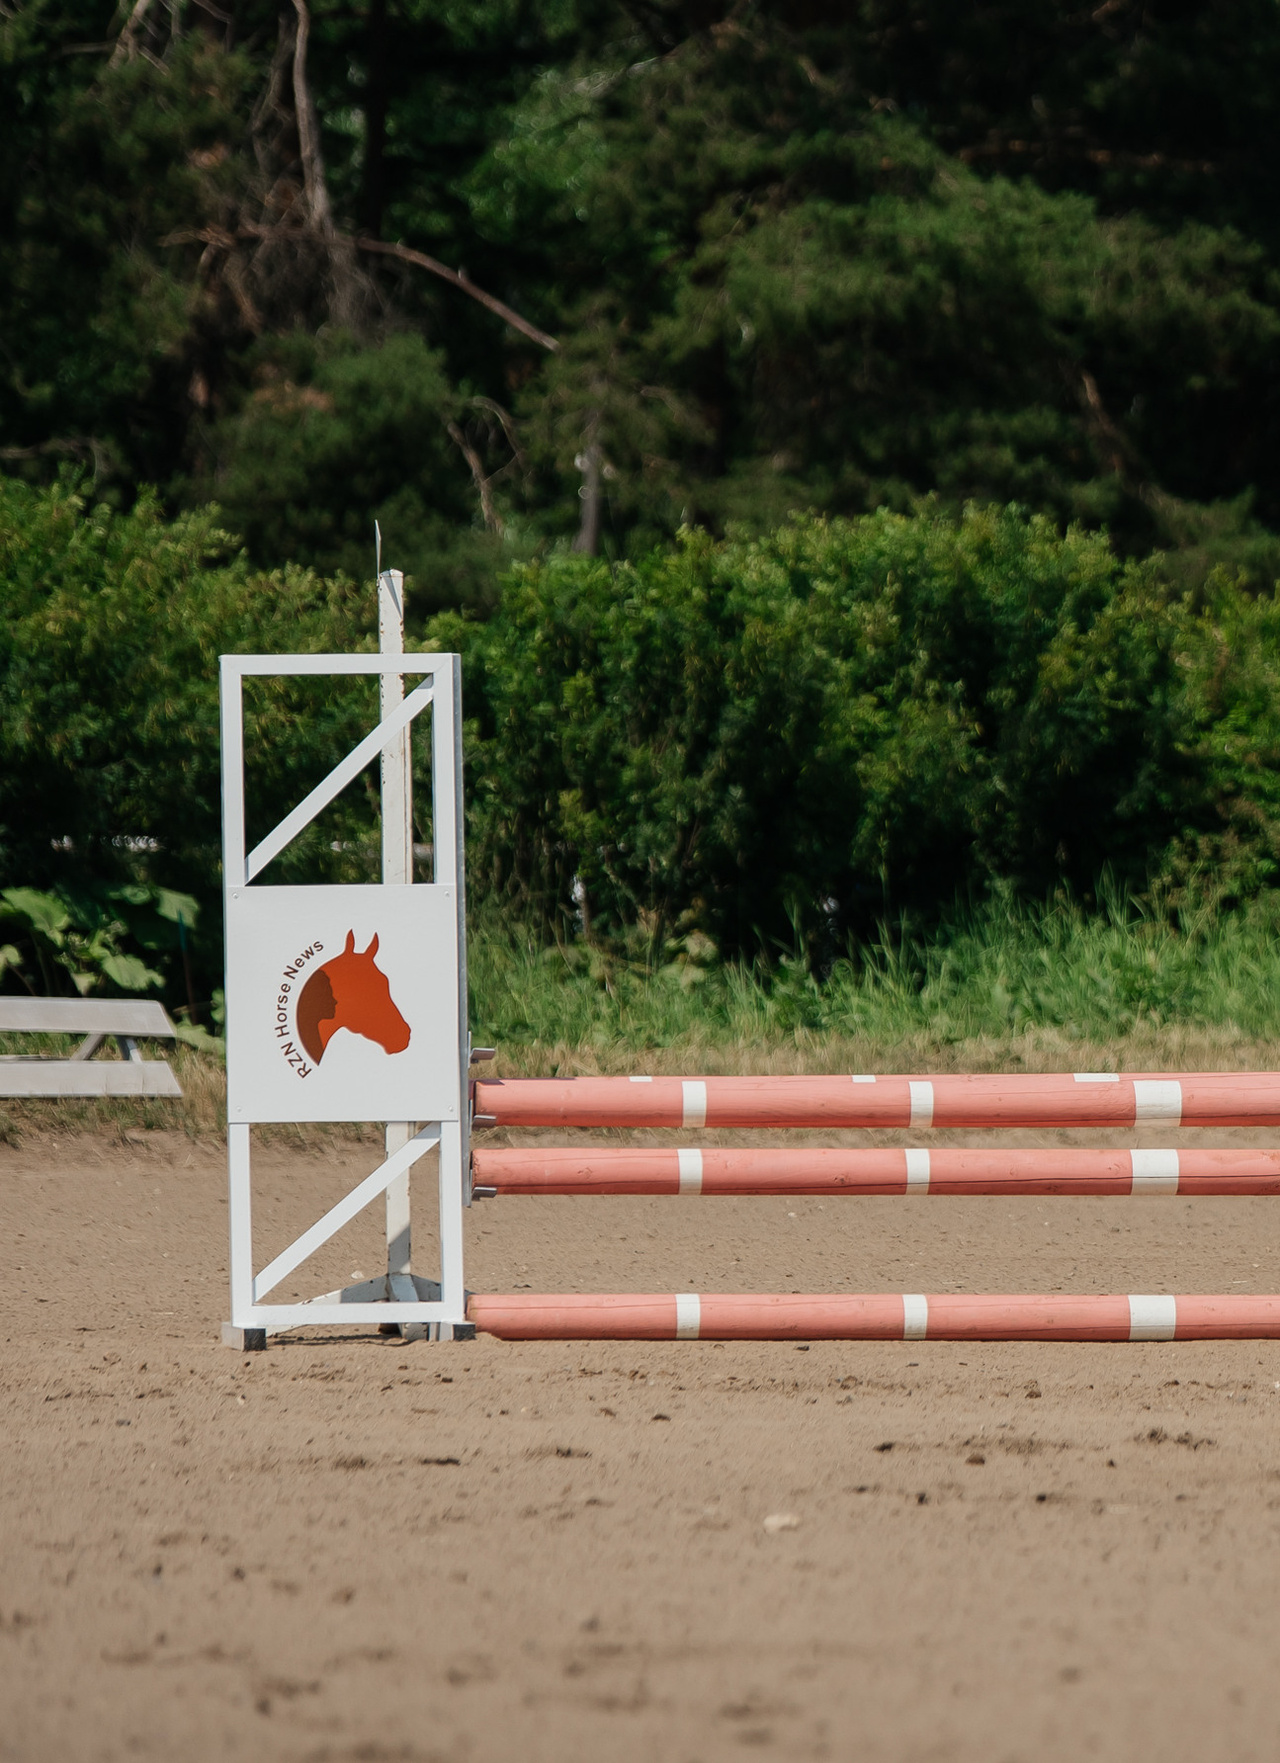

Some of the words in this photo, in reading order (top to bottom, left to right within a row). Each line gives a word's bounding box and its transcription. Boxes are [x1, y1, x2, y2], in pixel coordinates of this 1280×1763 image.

[283, 941, 324, 980] News
[274, 983, 291, 1038] Horse
[280, 1041, 312, 1079] RZN
